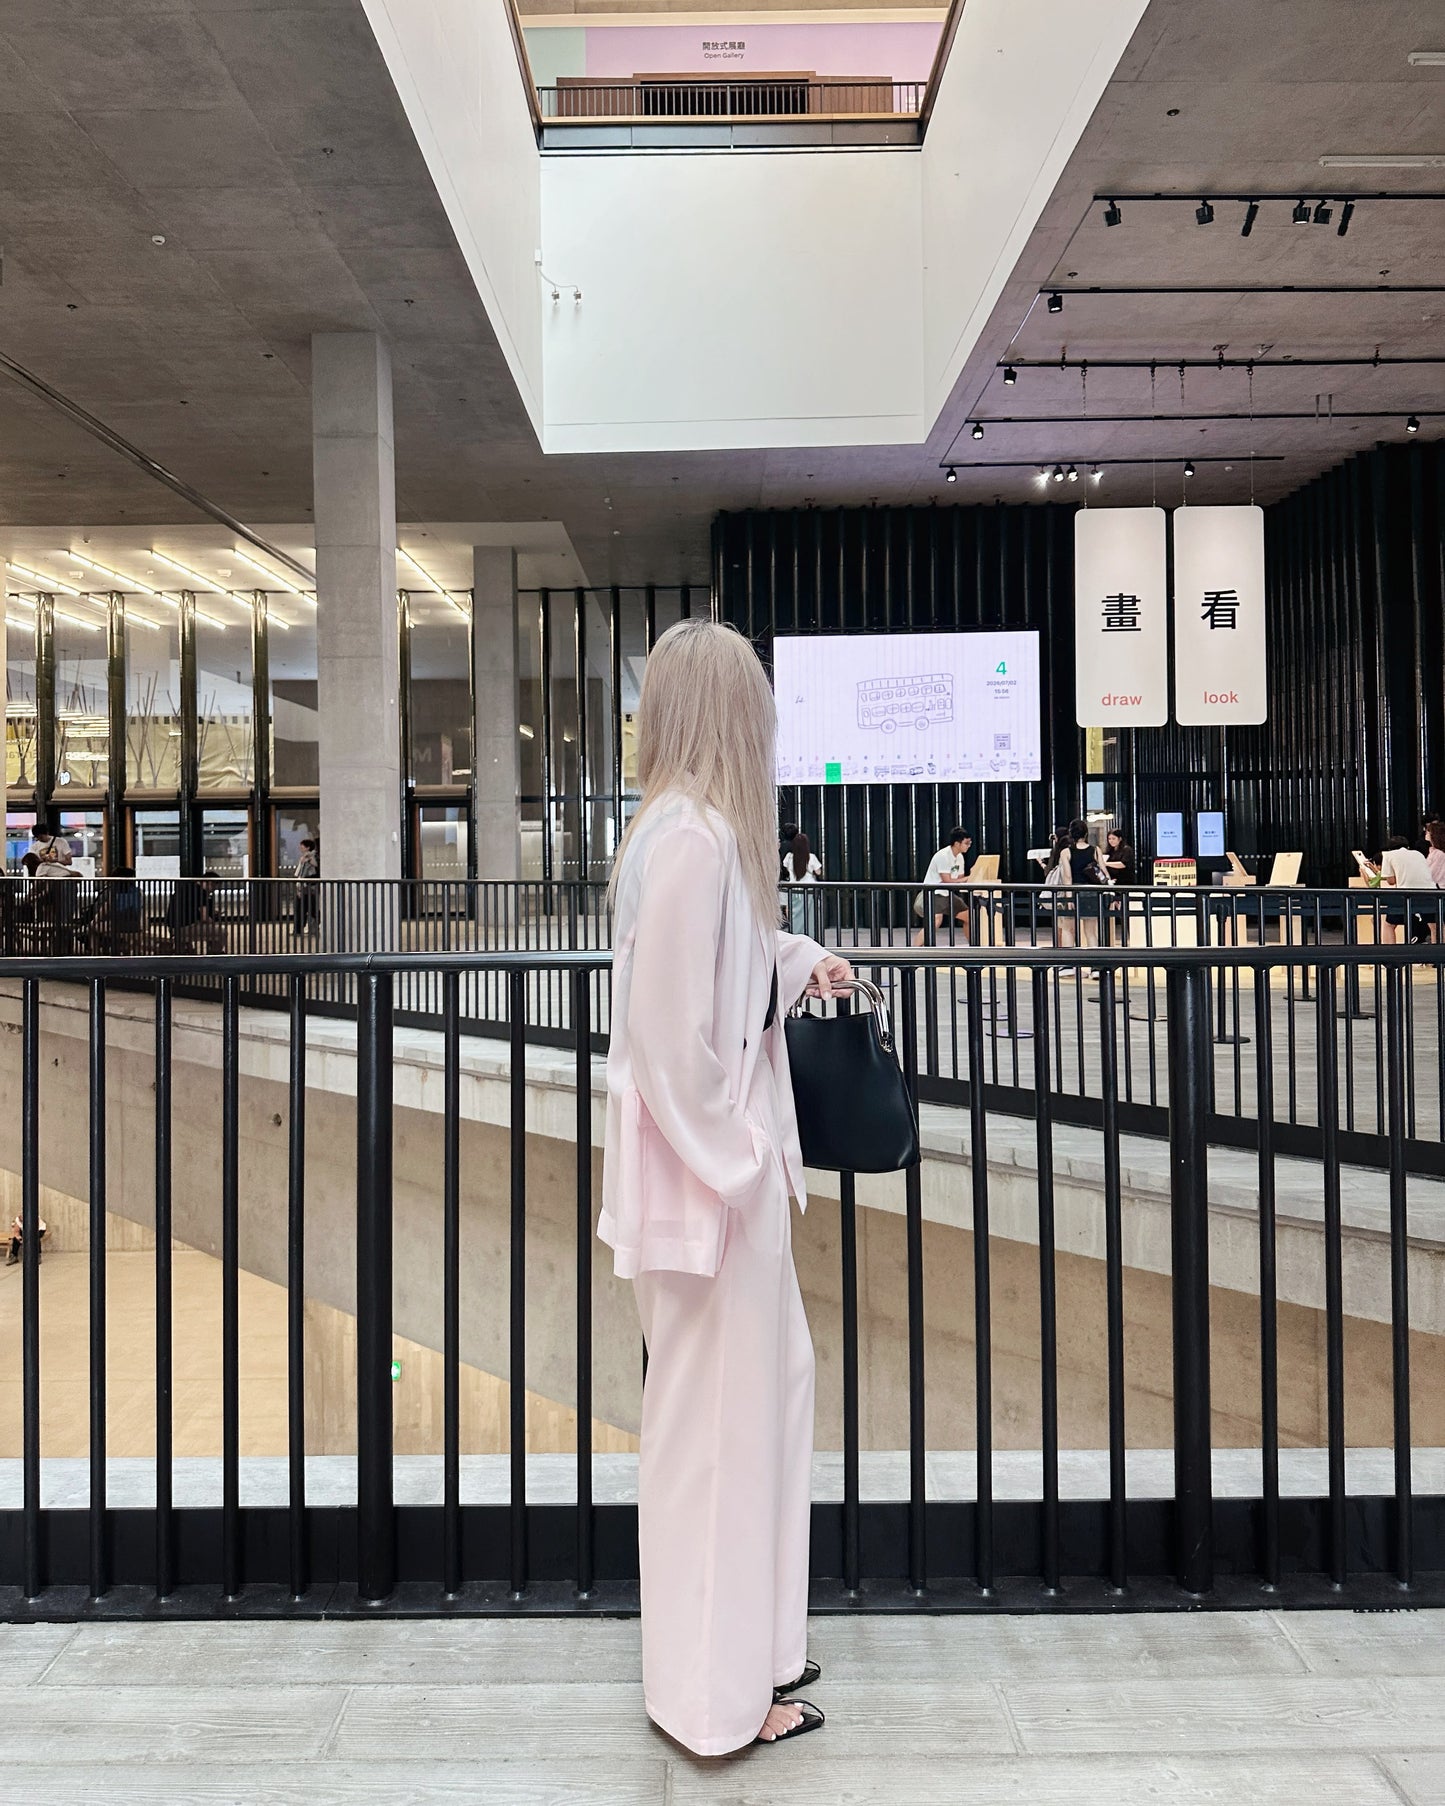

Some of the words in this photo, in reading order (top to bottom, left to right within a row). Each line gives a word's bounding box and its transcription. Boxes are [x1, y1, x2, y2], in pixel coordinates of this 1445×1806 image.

[702, 41, 745, 50] 開放式展廳
[1101, 592, 1142, 633] 畫
[1200, 589, 1241, 630] 看
[996, 661, 1007, 675] 4
[1101, 693, 1143, 706] draw
[1203, 690, 1240, 704] look
